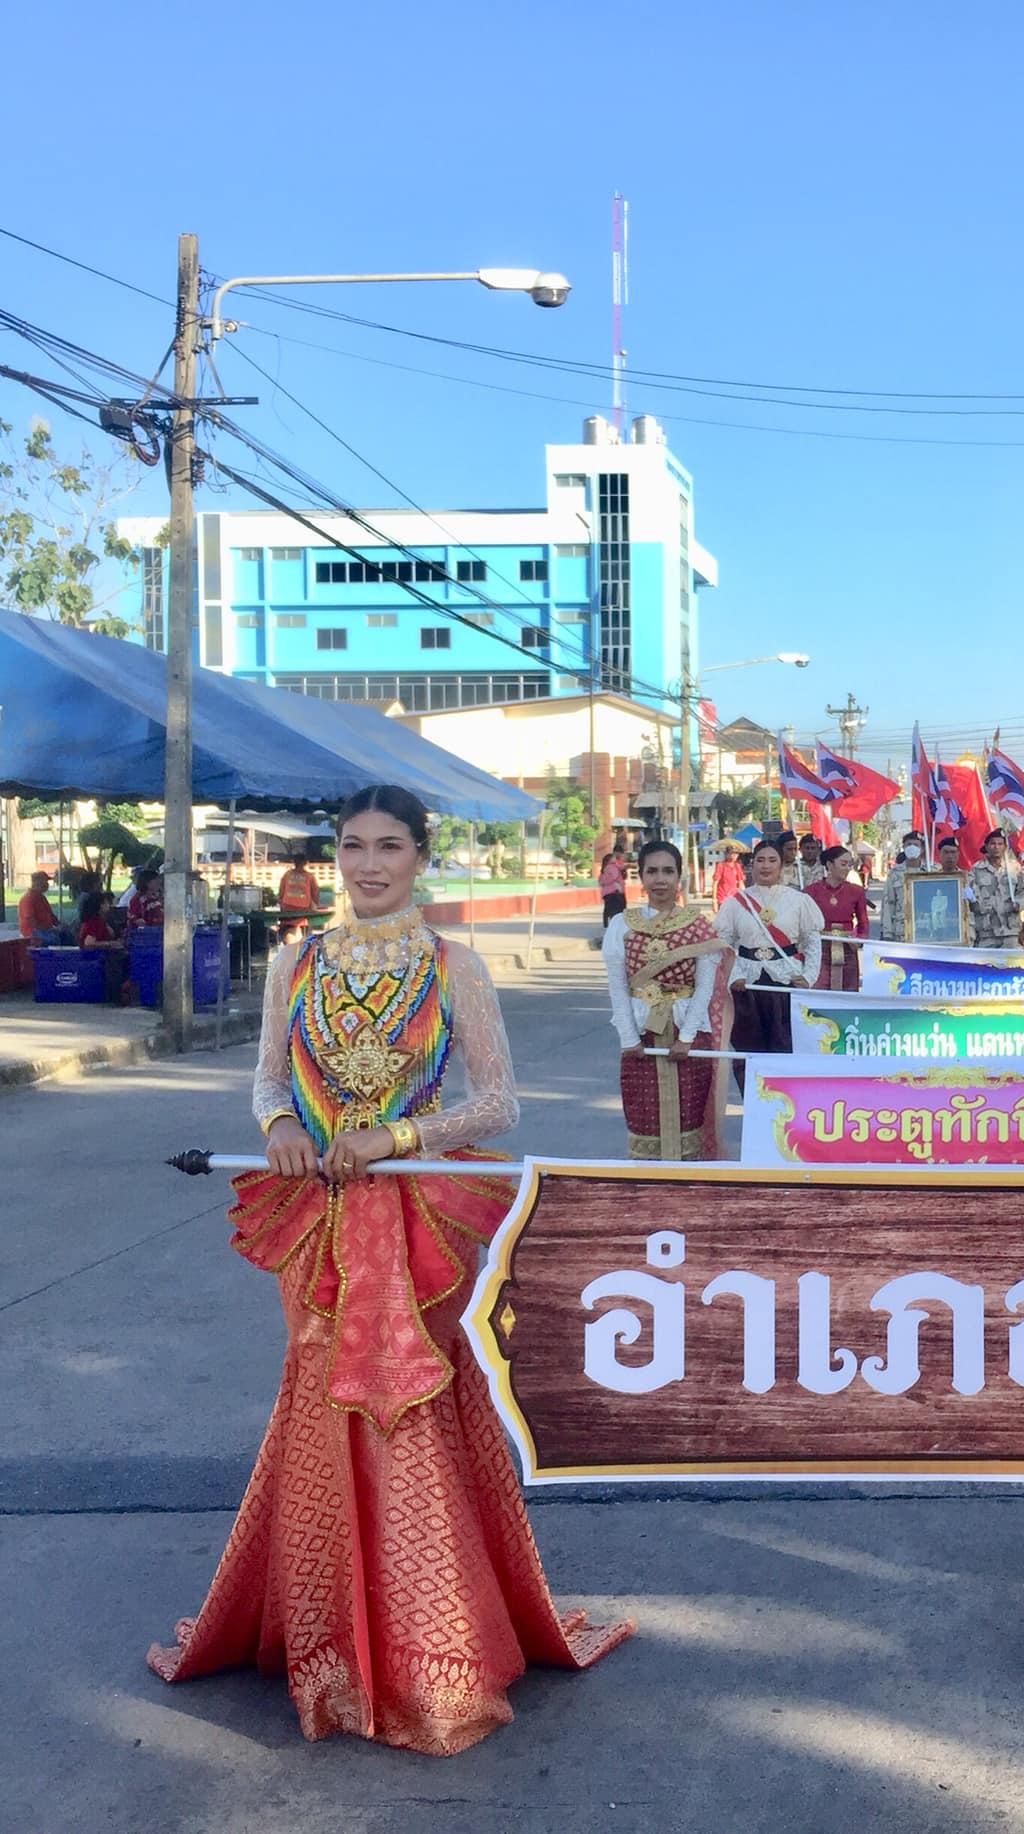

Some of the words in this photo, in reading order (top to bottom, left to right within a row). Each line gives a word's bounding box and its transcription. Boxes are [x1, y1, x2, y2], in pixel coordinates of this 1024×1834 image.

[844, 1016, 958, 1057] ถิ่นค่างแว่น
